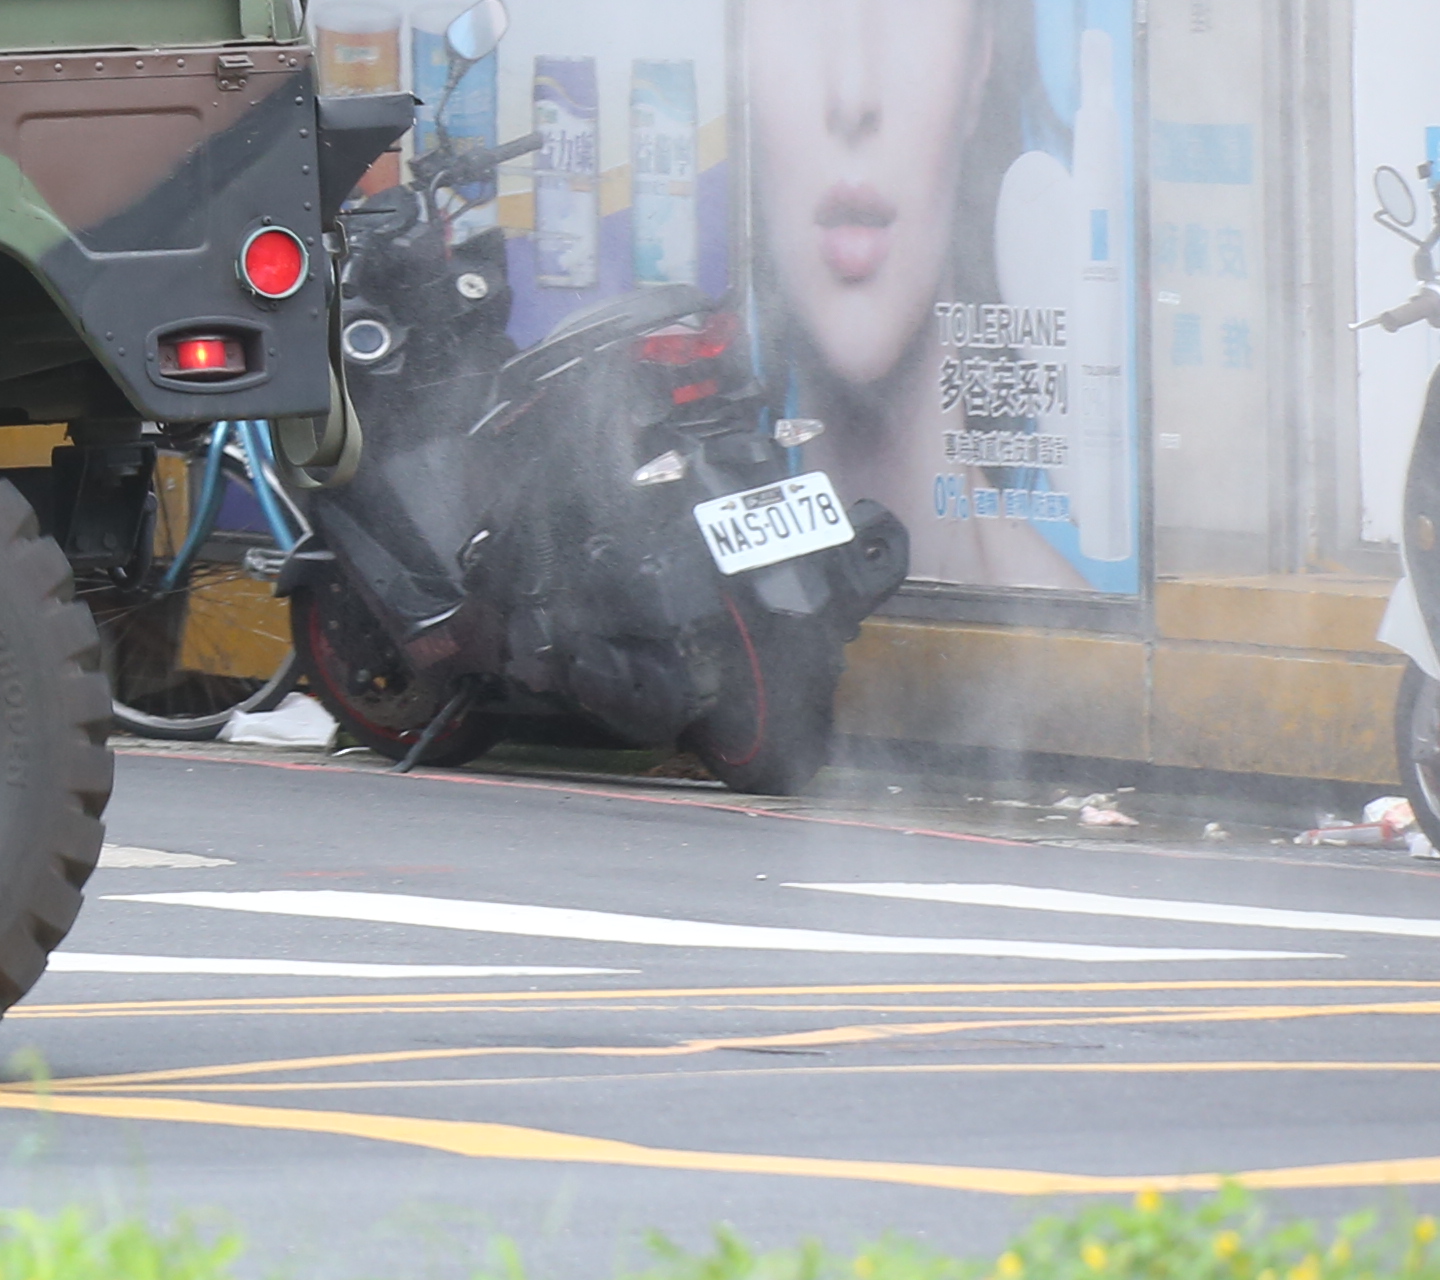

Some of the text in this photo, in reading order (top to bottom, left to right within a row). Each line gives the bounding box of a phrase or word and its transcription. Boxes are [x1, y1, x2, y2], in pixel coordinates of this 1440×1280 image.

[934, 302, 1069, 350] TOLERIANE
[938, 354, 1070, 417] 多容安系列
[708, 491, 840, 557] NAS-0178
[933, 473, 970, 520] 0%
